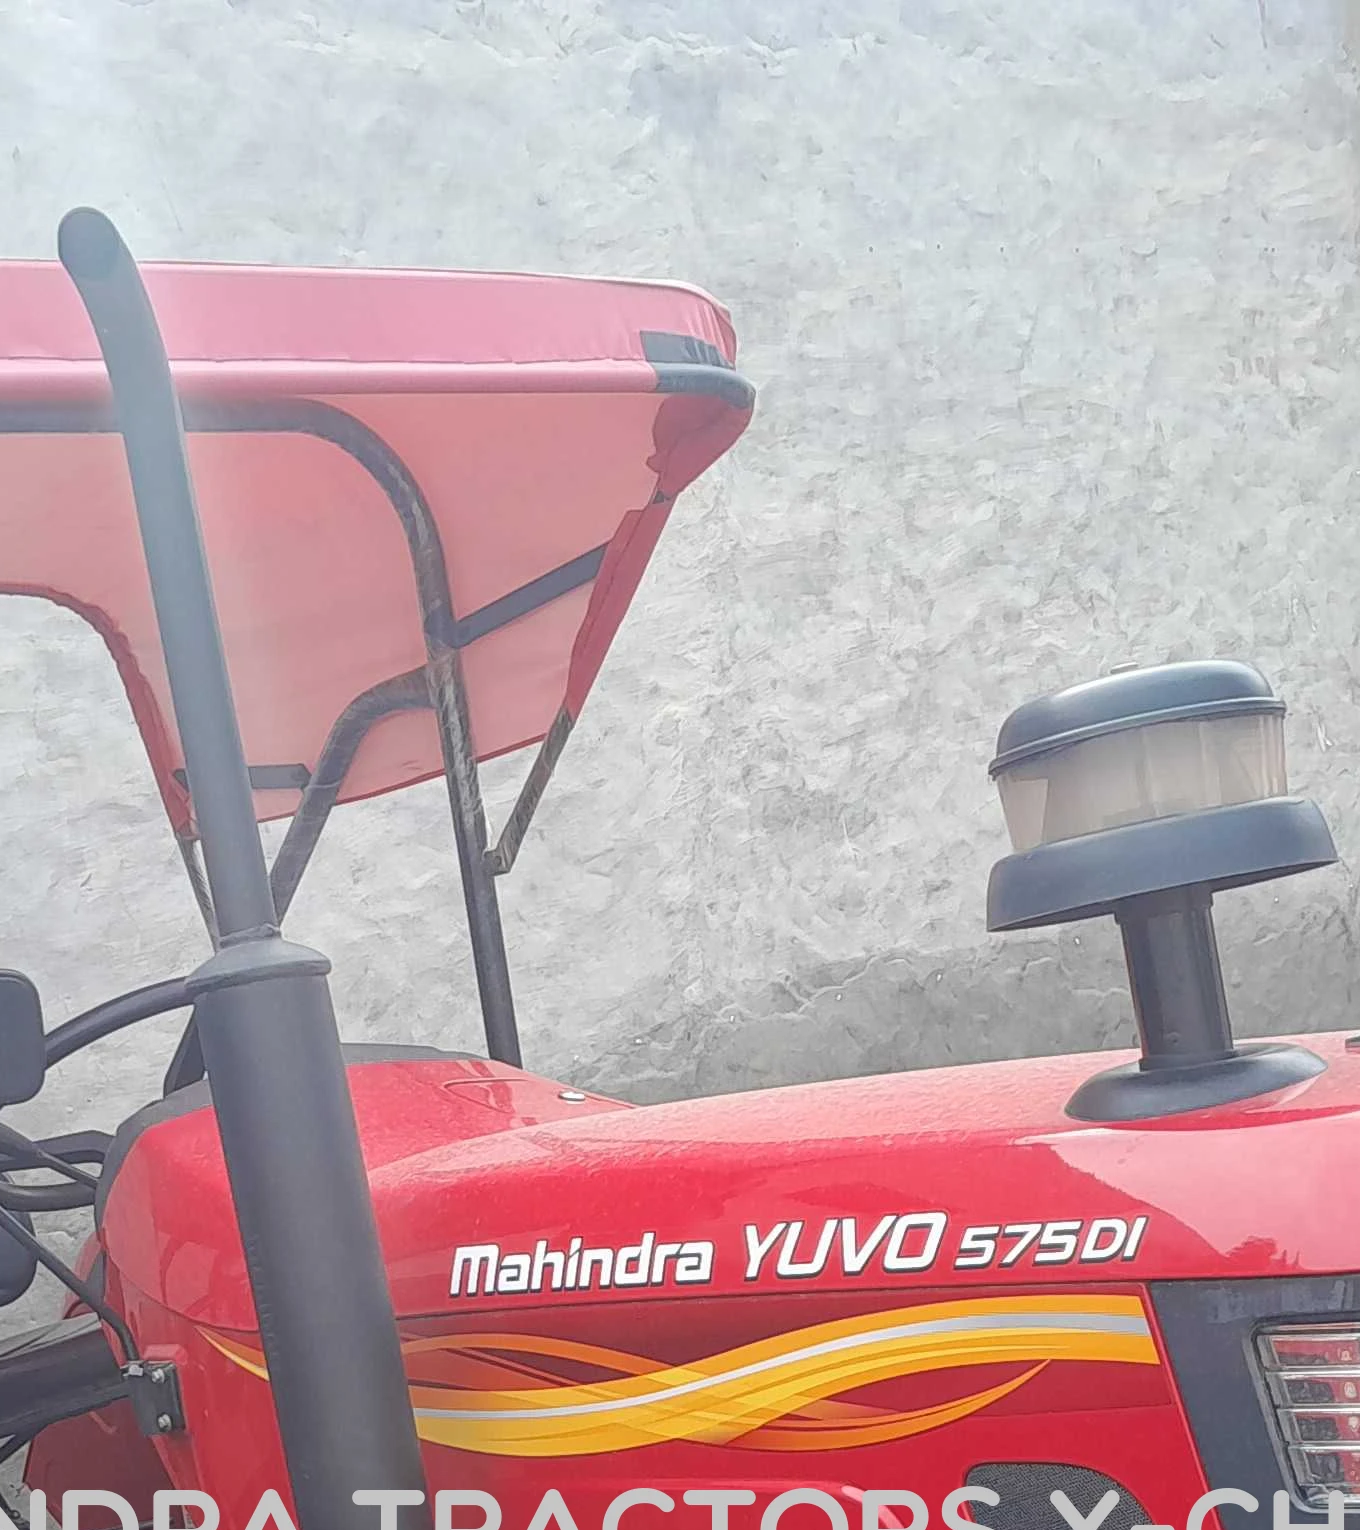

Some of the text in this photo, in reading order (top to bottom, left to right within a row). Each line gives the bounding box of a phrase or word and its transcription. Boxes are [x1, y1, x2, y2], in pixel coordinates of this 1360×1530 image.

[449, 1211, 1148, 1297] Mahindra YUVO 575DI
